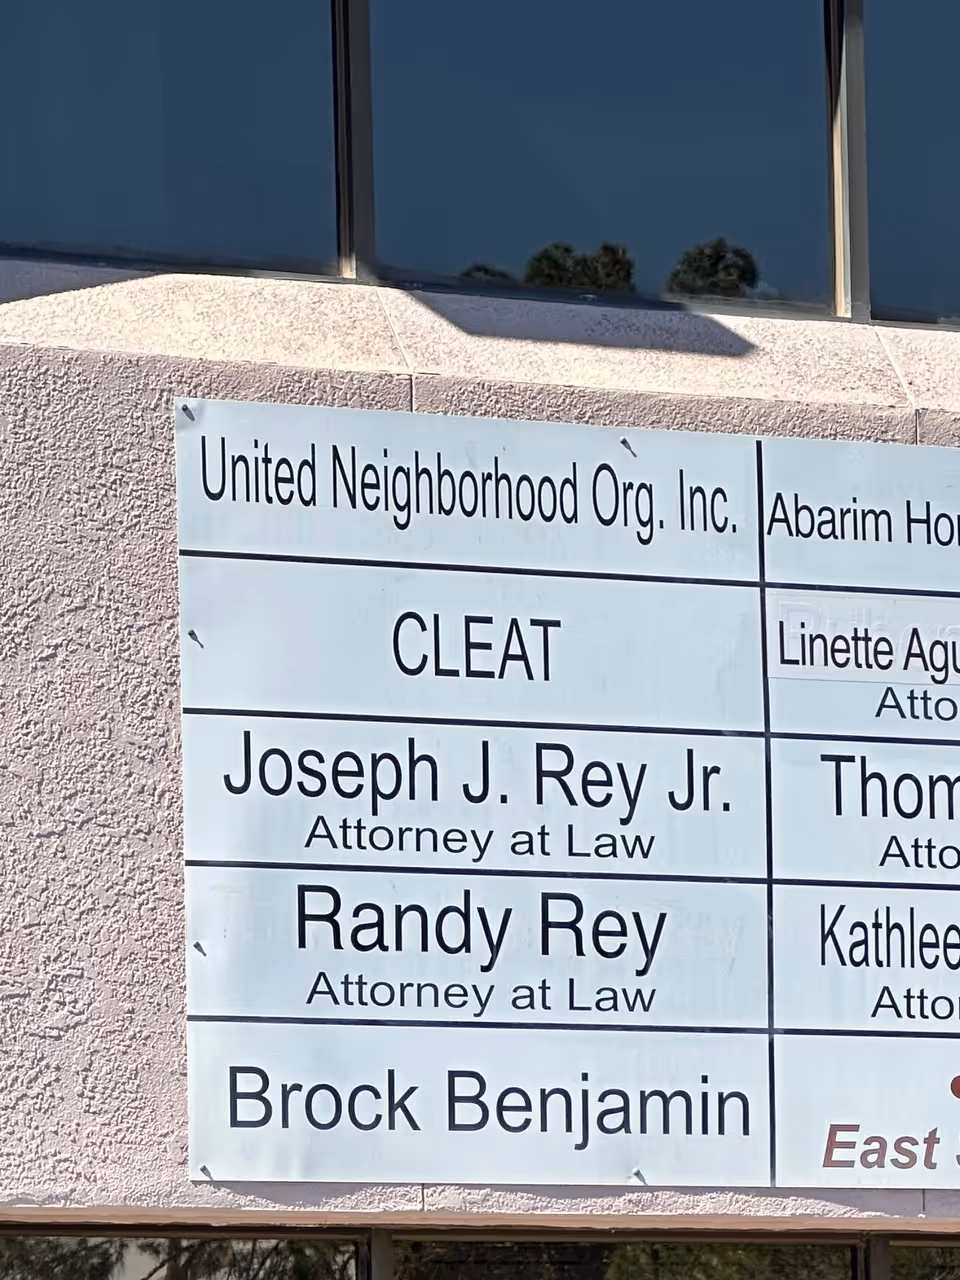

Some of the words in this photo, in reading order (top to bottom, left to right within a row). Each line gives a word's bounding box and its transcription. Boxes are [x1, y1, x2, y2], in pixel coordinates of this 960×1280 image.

[202, 436, 316, 507] United
[332, 445, 578, 530] Neighborhood
[593, 463, 664, 545] Org.
[679, 469, 736, 533] Inc.
[767, 493, 892, 542] Abarim
[393, 612, 561, 681] CLEAT
[779, 621, 893, 670] Linette
[224, 731, 438, 816] Joseph
[463, 741, 507, 804] J.
[536, 743, 648, 826] Rey
[668, 749, 730, 811] Jr.
[304, 815, 494, 863] Attorney
[511, 825, 550, 856] at
[568, 824, 655, 859] Law
[298, 885, 512, 972] Randy
[541, 892, 667, 977] Rey
[306, 972, 495, 1017] Attorney
[512, 979, 551, 1010] at
[569, 978, 656, 1012] Law
[230, 1066, 421, 1130] Brock
[448, 1070, 749, 1150] Benjamin
[823, 1123, 941, 1170] East
